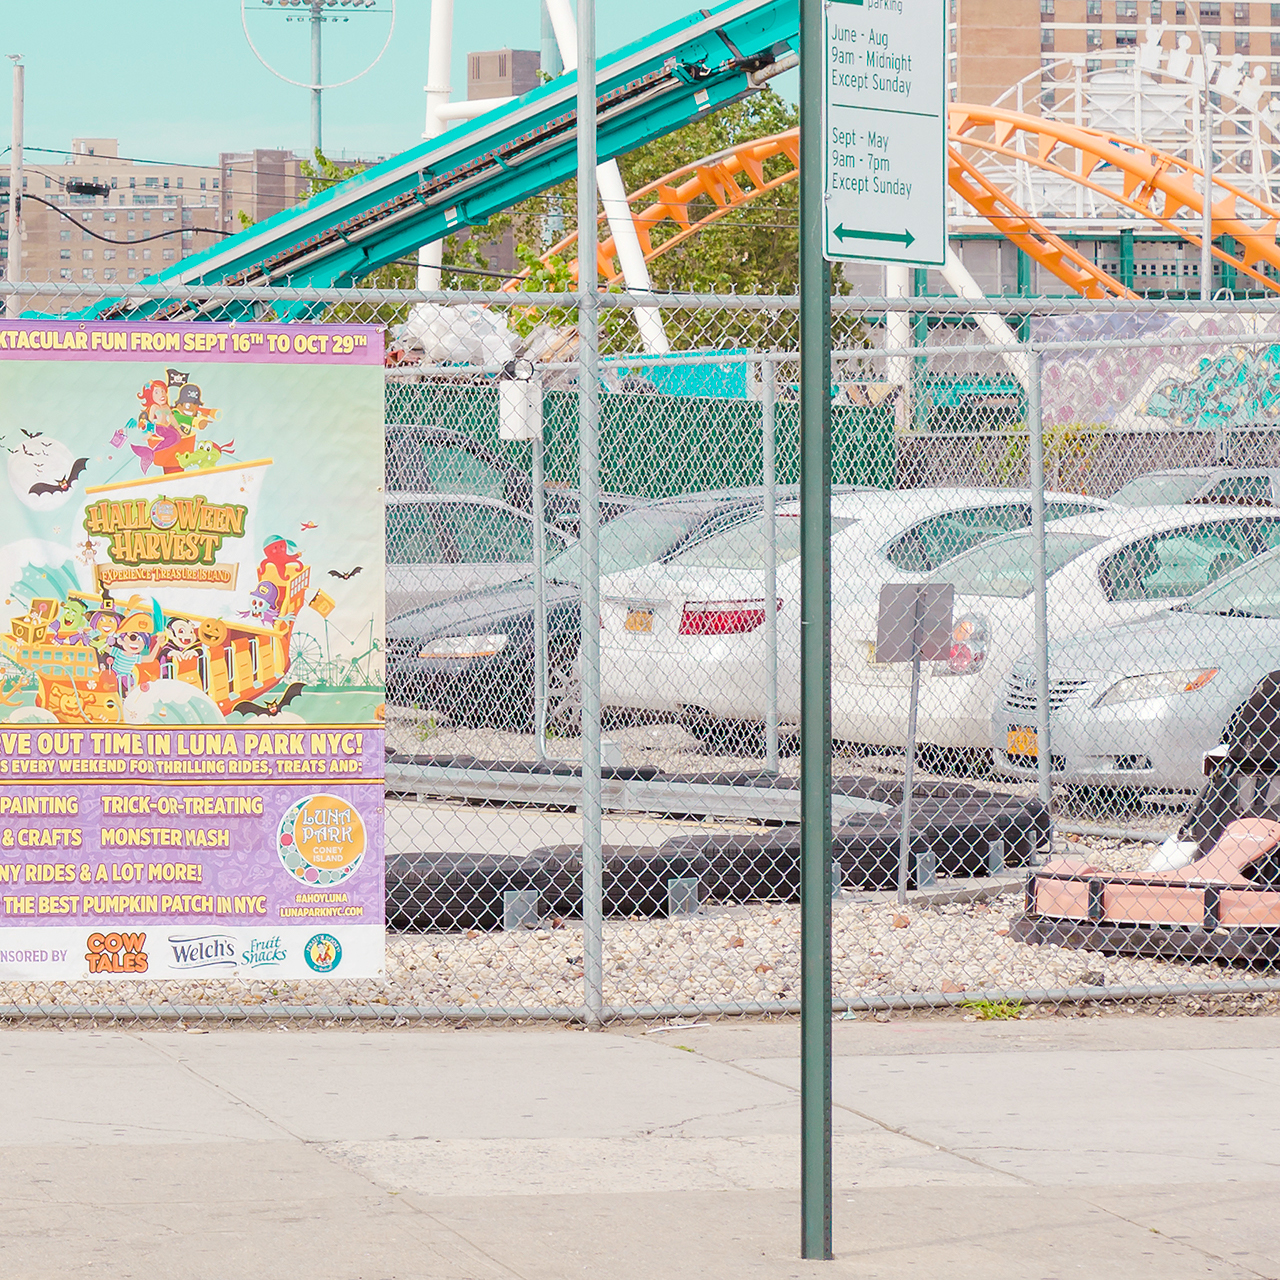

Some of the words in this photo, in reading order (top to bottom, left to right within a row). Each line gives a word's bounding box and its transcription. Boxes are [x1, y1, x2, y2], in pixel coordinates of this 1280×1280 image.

[831, 24, 857, 42] June
[868, 28, 889, 50] Aug
[831, 46, 854, 65] 9am
[866, 50, 912, 74] Midnight
[832, 69, 868, 92] Except
[872, 74, 912, 98] Sunday
[832, 127, 856, 148] Sept
[868, 131, 889, 153] May
[832, 149, 855, 168] 9am
[868, 153, 890, 174] 7pm
[832, 172, 869, 195] Except
[873, 176, 912, 200] Sunday
[91, 331, 127, 350] FUN
[130, 332, 180, 351] FROM
[183, 333, 228, 351] SEPT
[231, 333, 264, 352] 16TH
[267, 334, 290, 352] TO
[293, 334, 329, 353] OCT
[332, 335, 367, 353] 29TH
[88, 496, 245, 534] HALLOWEEN
[111, 529, 219, 562] HARVEST
[101, 569, 151, 585] EXPERIENCE
[151, 566, 198, 582] TREASURE
[198, 569, 232, 582] ISLAND
[37, 732, 84, 755] OUT
[91, 733, 144, 755] TIME
[147, 733, 171, 755] IN
[177, 733, 238, 755] LUNA
[244, 733, 304, 755] PARK
[311, 732, 363, 755] NYC!
[11, 759, 55, 773] EVERY
[58, 759, 126, 773] WEEKEND
[129, 759, 155, 773] FOR
[157, 760, 225, 773] THRILLING
[228, 760, 273, 775] RIDES,
[276, 759, 326, 773] TREATS
[329, 759, 363, 772] AND:
[0, 796, 78, 814] PAINTING
[101, 796, 264, 814] TRICK-OR-TREATING
[302, 808, 352, 826] LUNA
[1, 828, 15, 847] &
[17, 828, 83, 847] CRAFTS
[101, 827, 182, 846] MONSTER
[185, 829, 230, 847] MASH
[302, 826, 354, 844] PARK
[313, 846, 344, 854] CONEY
[313, 854, 344, 862] ISLAND
[25, 864, 76, 882] RIDES
[79, 863, 92, 882] &
[95, 863, 108, 882] A
[112, 863, 144, 881] LOT
[148, 863, 203, 882] MORE!
[3, 896, 35, 914] THE
[38, 895, 80, 914] BEST
[83, 895, 158, 913] PUMPKIN
[161, 895, 214, 913] PATCH
[217, 896, 232, 913] IN
[234, 895, 267, 914] NYC
[295, 893, 348, 903] #AHOYLUNA
[280, 906, 363, 918] LUNAPARKNYC.COM
[86, 932, 147, 954] COW
[171, 939, 235, 963] Welch's
[250, 935, 282, 953] Fruit
[51, 949, 68, 962] BY
[85, 952, 149, 974] TALES
[241, 949, 288, 966] Snacks
